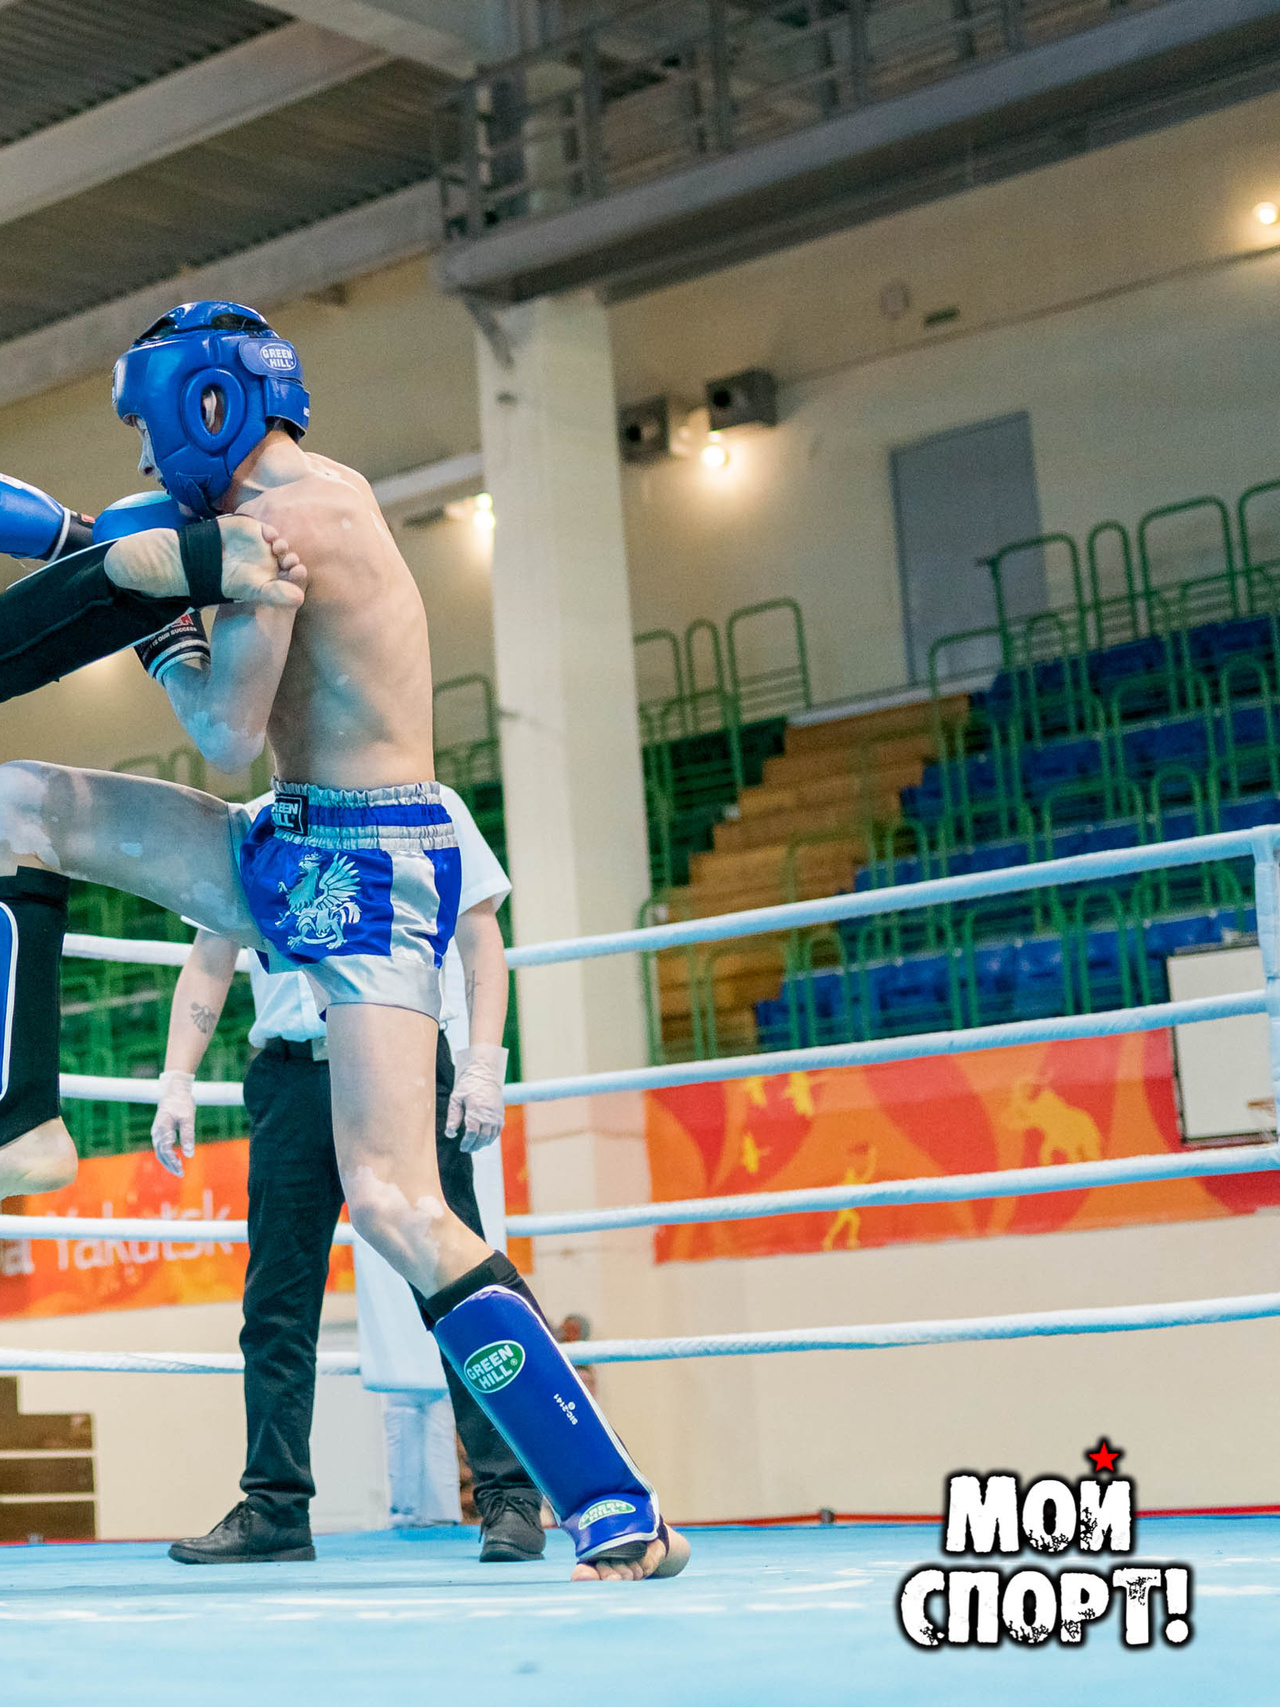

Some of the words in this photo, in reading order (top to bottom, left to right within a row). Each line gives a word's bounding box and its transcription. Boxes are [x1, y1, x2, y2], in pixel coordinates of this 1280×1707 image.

[262, 349, 293, 359] GREEN
[269, 359, 291, 368] HILL
[466, 1344, 515, 1381] GREEN
[478, 1363, 514, 1390] HILL
